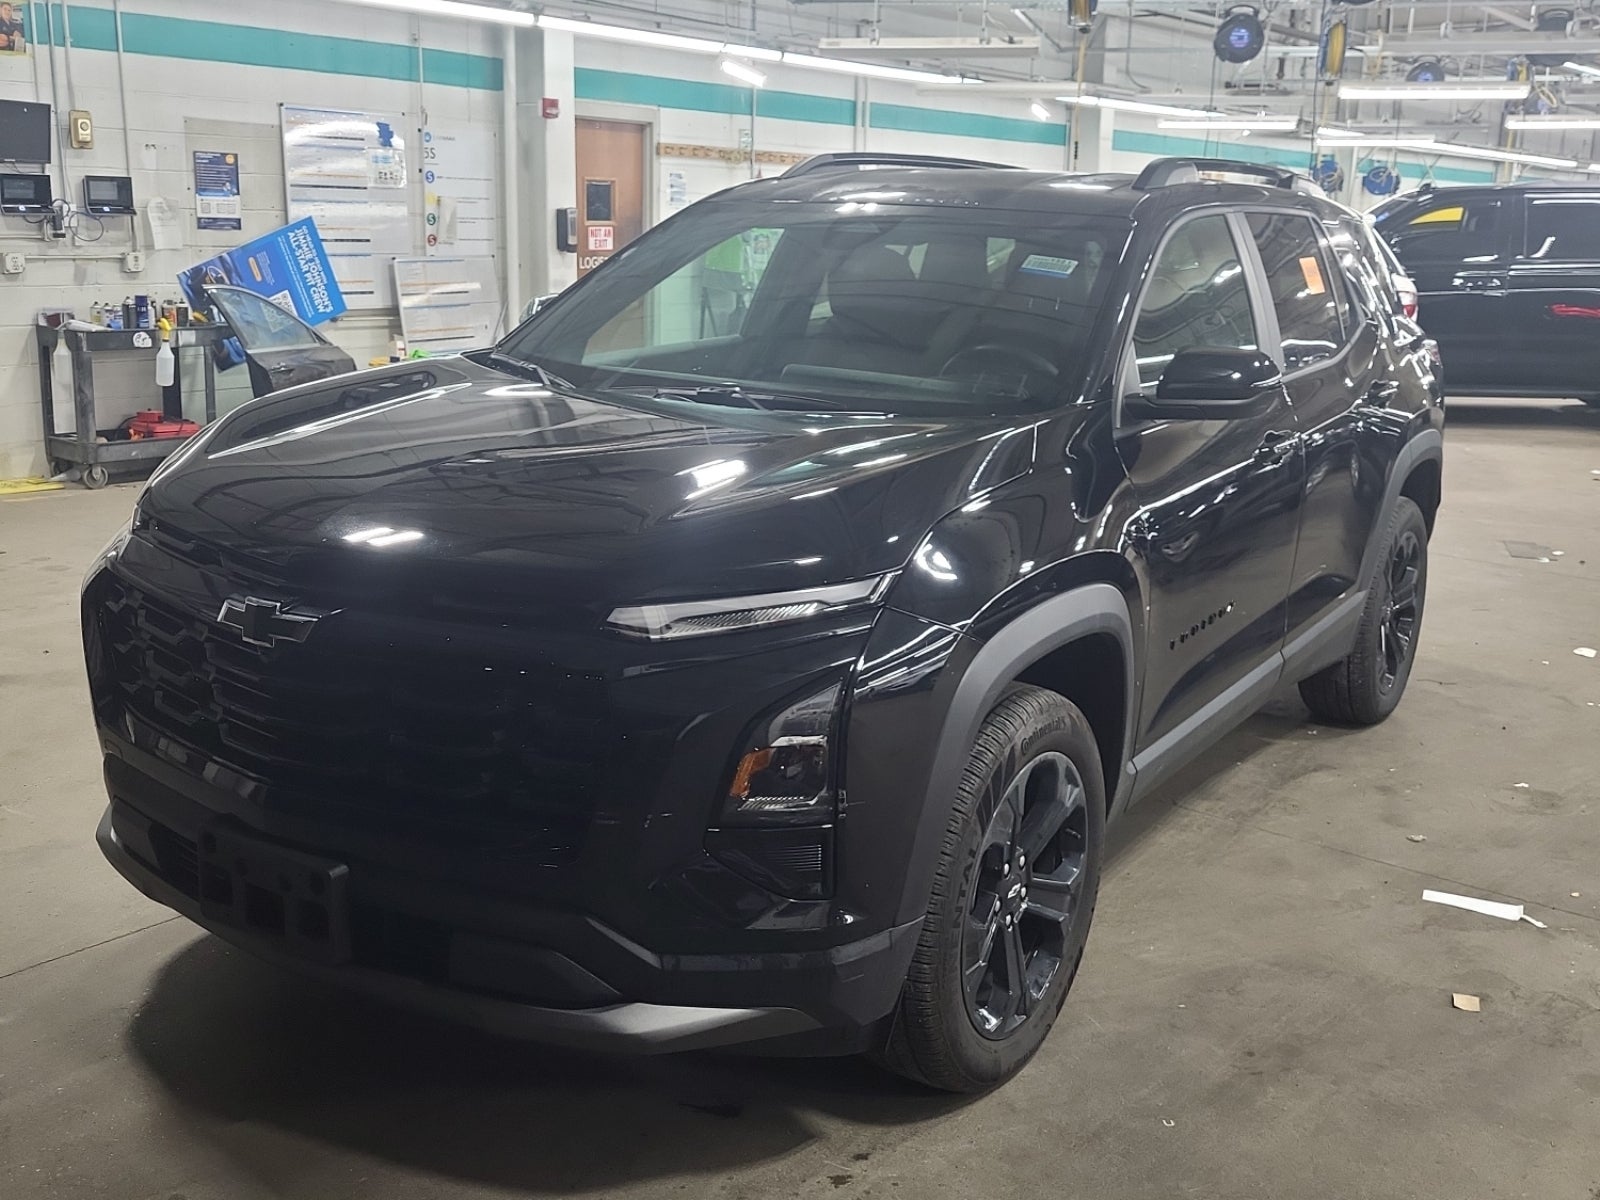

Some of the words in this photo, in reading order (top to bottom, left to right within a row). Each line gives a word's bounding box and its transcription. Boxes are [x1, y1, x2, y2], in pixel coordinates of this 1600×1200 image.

[590, 228, 601, 238] NOT
[594, 238, 608, 249] EXIT
[287, 231, 309, 272] ALL-STAR
[304, 271, 314, 286] PIT
[309, 286, 327, 313] CREW
[295, 228, 312, 260] JIMMIE
[307, 260, 334, 312] JOHNSON'S
